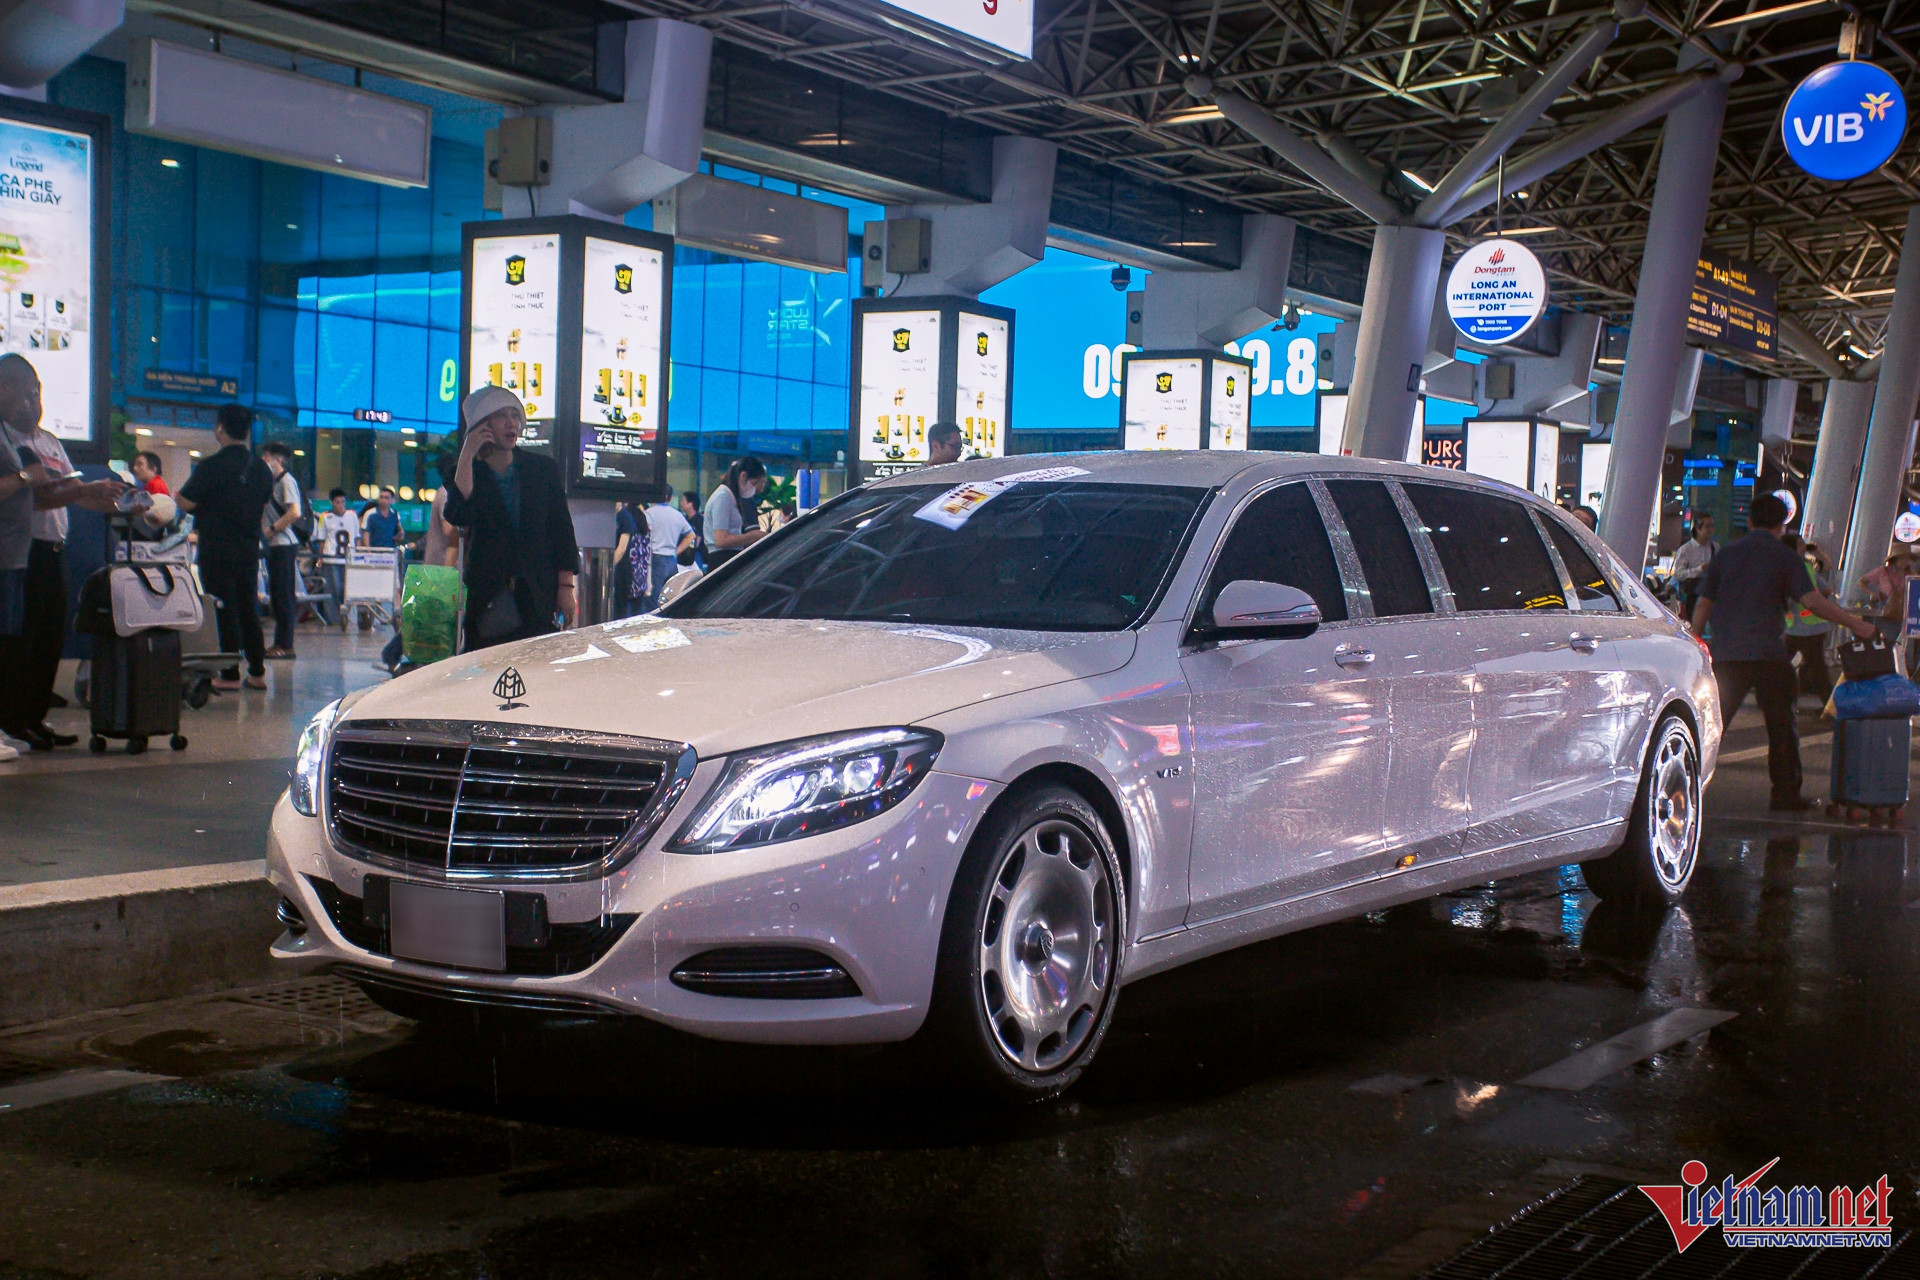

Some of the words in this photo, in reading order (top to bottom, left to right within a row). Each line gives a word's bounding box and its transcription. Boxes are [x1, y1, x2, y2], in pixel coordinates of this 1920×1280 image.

[1794, 113, 1864, 147] VIB
[10, 157, 43, 172] Legend
[1471, 281, 1499, 290] LONG
[1501, 280, 1517, 289] AN
[1452, 291, 1534, 300] INTERNATIONAL
[1478, 303, 1506, 311] PORT
[221, 380, 237, 395] A2
[335, 530, 349, 556] 8
